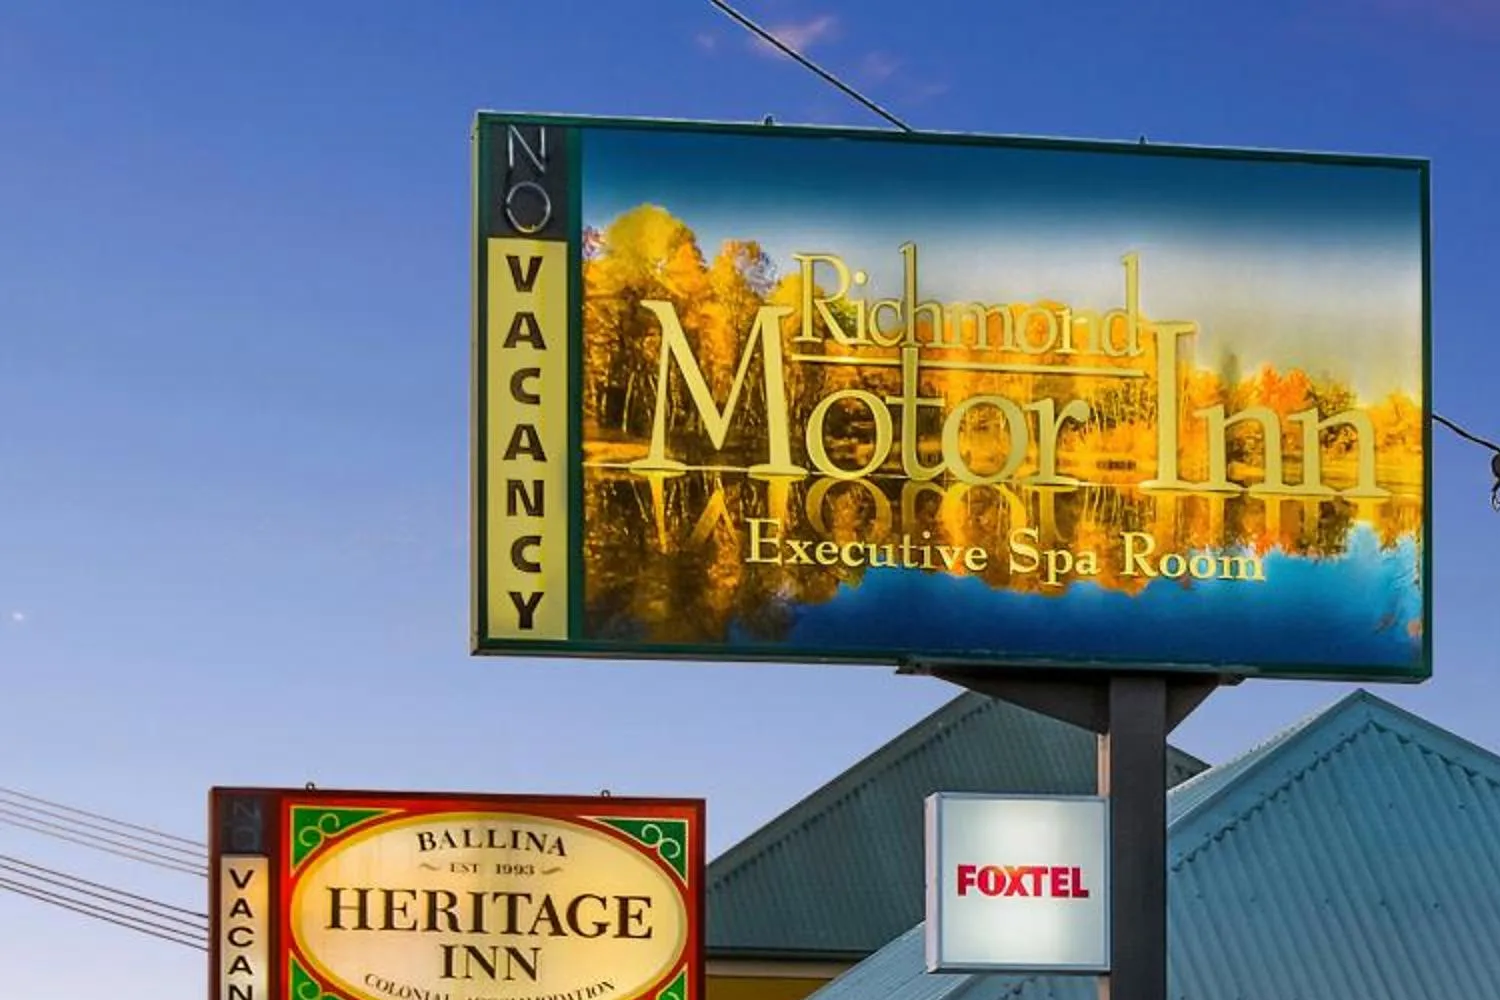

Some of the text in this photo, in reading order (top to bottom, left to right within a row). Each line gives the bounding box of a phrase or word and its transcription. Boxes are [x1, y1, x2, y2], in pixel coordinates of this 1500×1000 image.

[506, 123, 551, 234] NO
[792, 242, 1143, 358] Richmond
[630, 299, 1393, 498] Motor Inn
[502, 254, 547, 632] VACANCY
[744, 518, 1266, 586] Executive Spa Room
[417, 828, 567, 857] BALLINA
[449, 862, 535, 876] EST 1993
[957, 864, 1090, 898] FOXTEL
[325, 887, 653, 940] HERITAGE
[440, 944, 542, 982] INN
